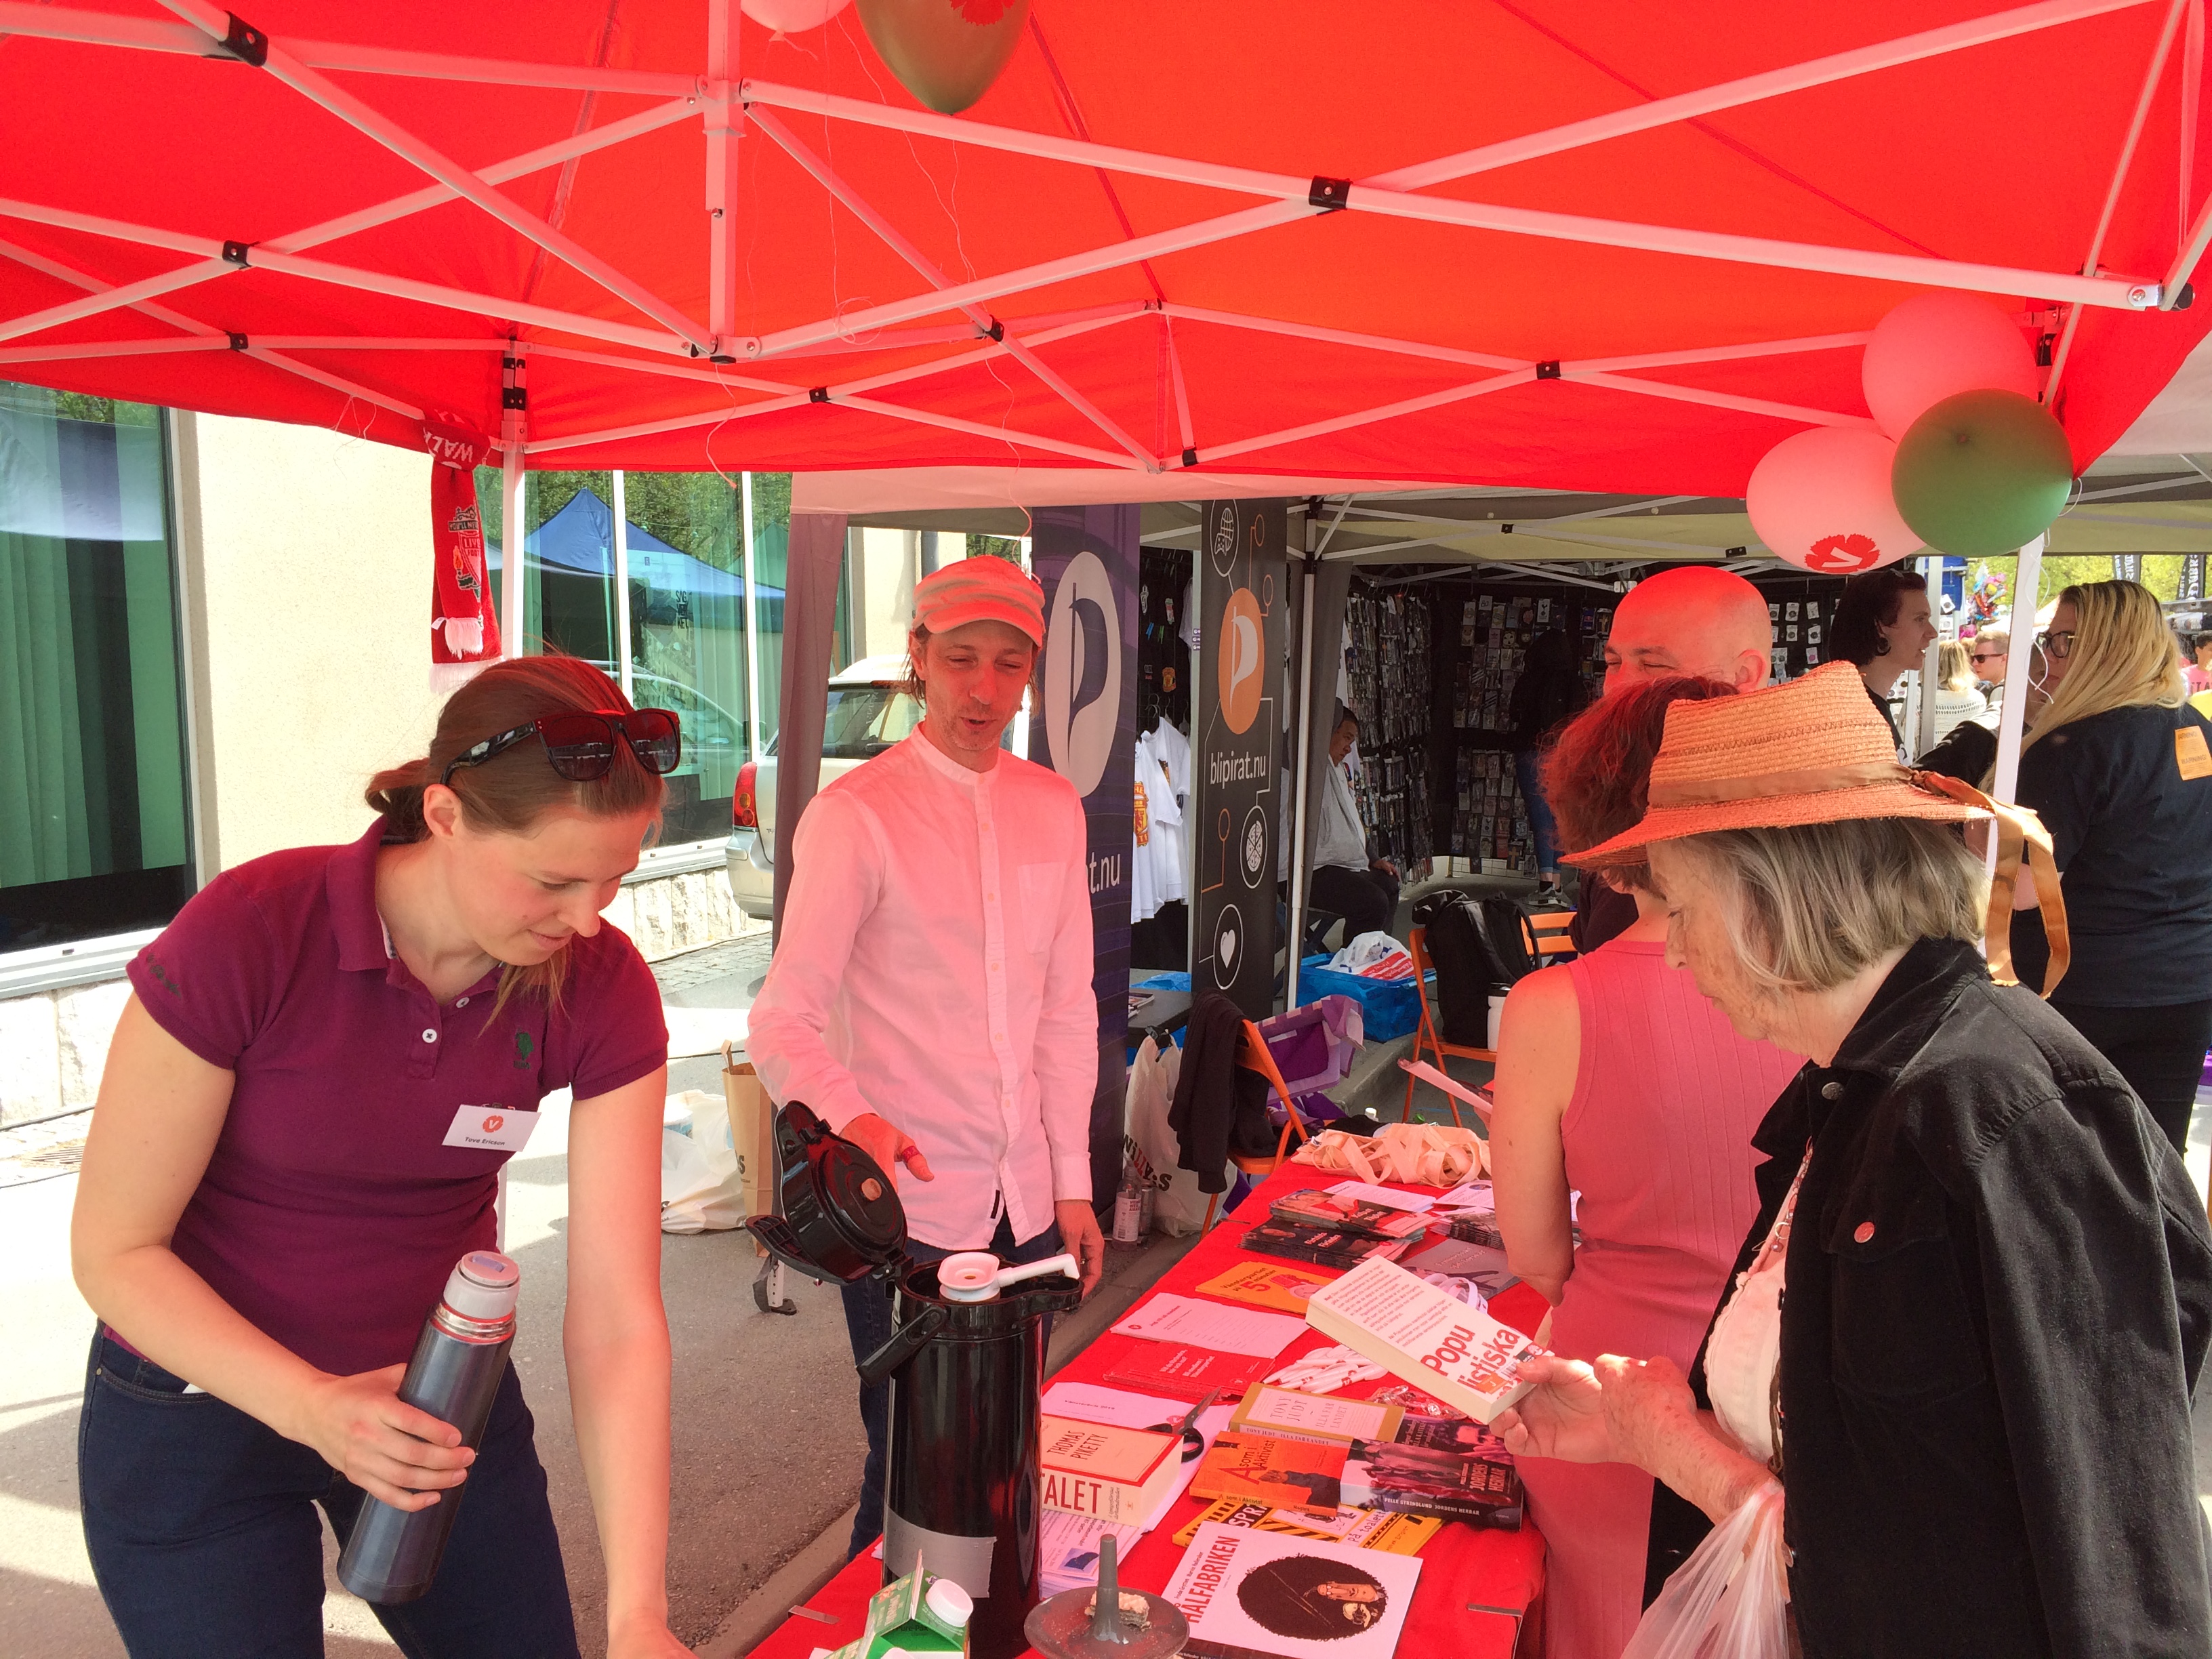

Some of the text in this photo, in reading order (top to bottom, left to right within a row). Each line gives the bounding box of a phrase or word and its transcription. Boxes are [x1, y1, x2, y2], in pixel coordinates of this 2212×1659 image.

[1210, 751, 1266, 789] blipirat.nu
[1240, 1281, 1271, 1292] 5
[1420, 1324, 1475, 1376] Popu
[1456, 1329, 1521, 1395] listiska
[1270, 1396, 1291, 1418] TONY
[1286, 1399, 1307, 1421] JUDT
[1330, 1406, 1348, 1428] LANDET
[1315, 1411, 1329, 1428] ILLA
[1046, 1430, 1085, 1456] THOMAS
[1069, 1433, 1109, 1460] PIKETTY
[1246, 1427, 1261, 1435] TONY
[1307, 1437, 1329, 1446] LANDET
[1255, 1440, 1277, 1469] Aktivist
[1469, 1463, 1488, 1492] JORDENS
[1488, 1467, 1507, 1492] HERRAR
[1242, 1497, 1263, 1505] Aktivist
[1399, 1500, 1433, 1509] STRINDLUND
[1458, 1507, 1480, 1516] HERRAR
